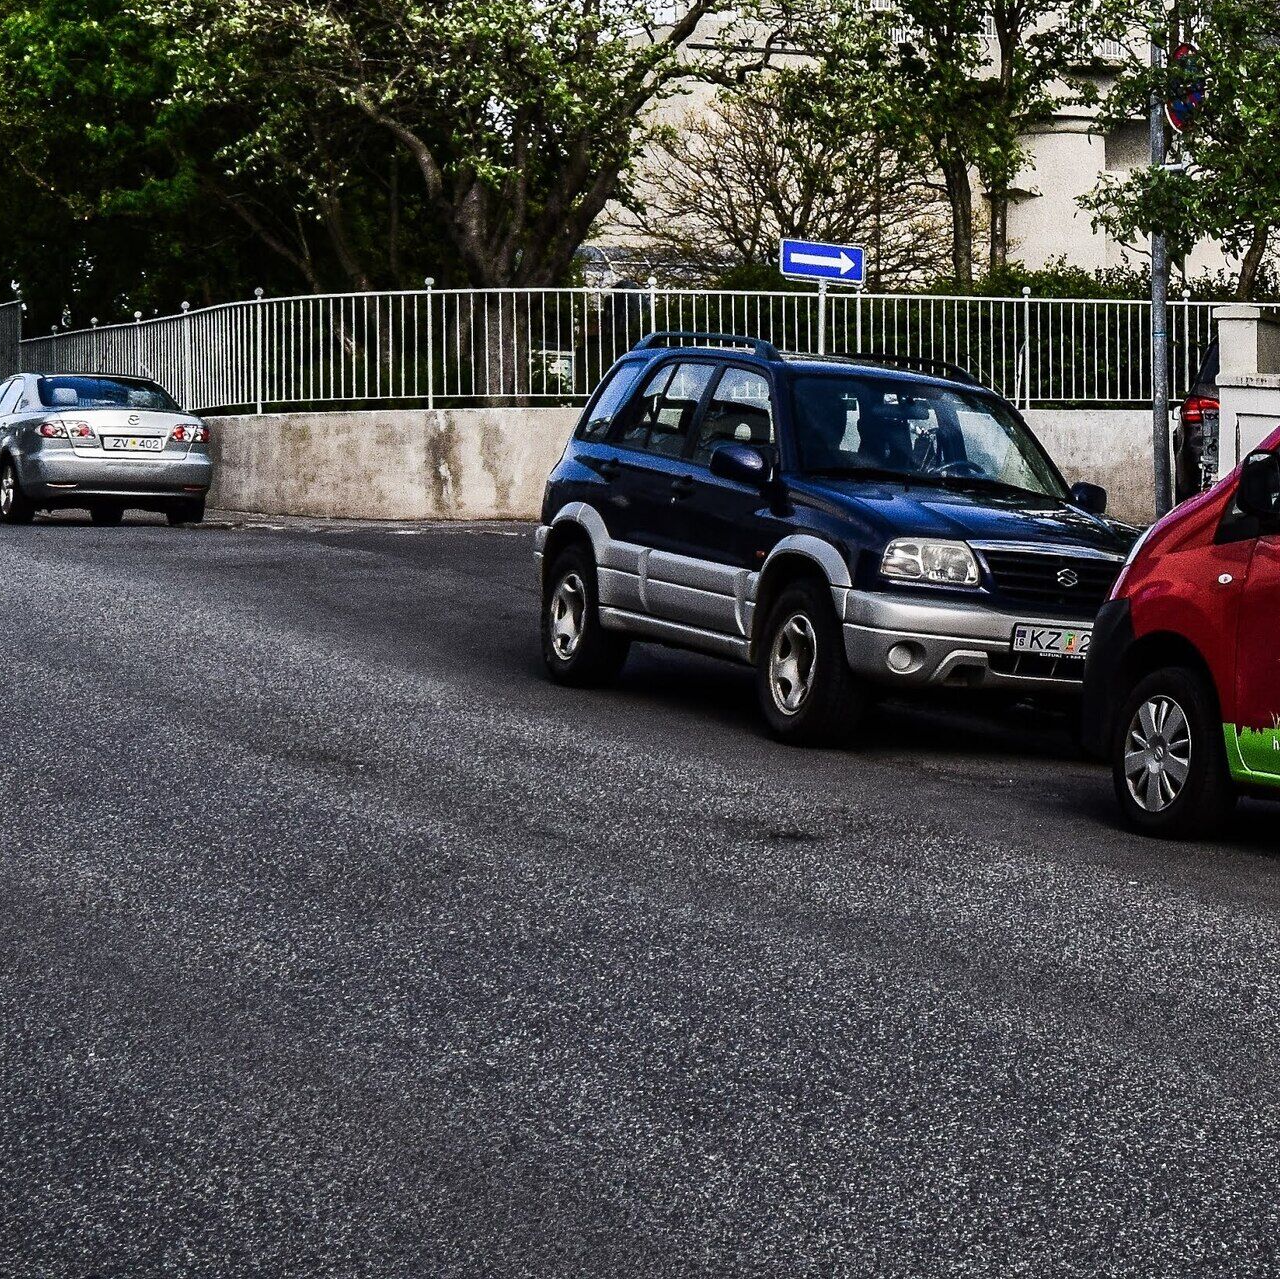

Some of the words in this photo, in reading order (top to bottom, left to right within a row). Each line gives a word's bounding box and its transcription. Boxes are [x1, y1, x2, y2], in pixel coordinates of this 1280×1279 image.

[112, 438, 129, 448] ZV
[139, 439, 159, 449] 402
[1015, 638, 1025, 646] IS
[1029, 629, 1062, 650] KZ
[1078, 634, 1092, 654] 2
